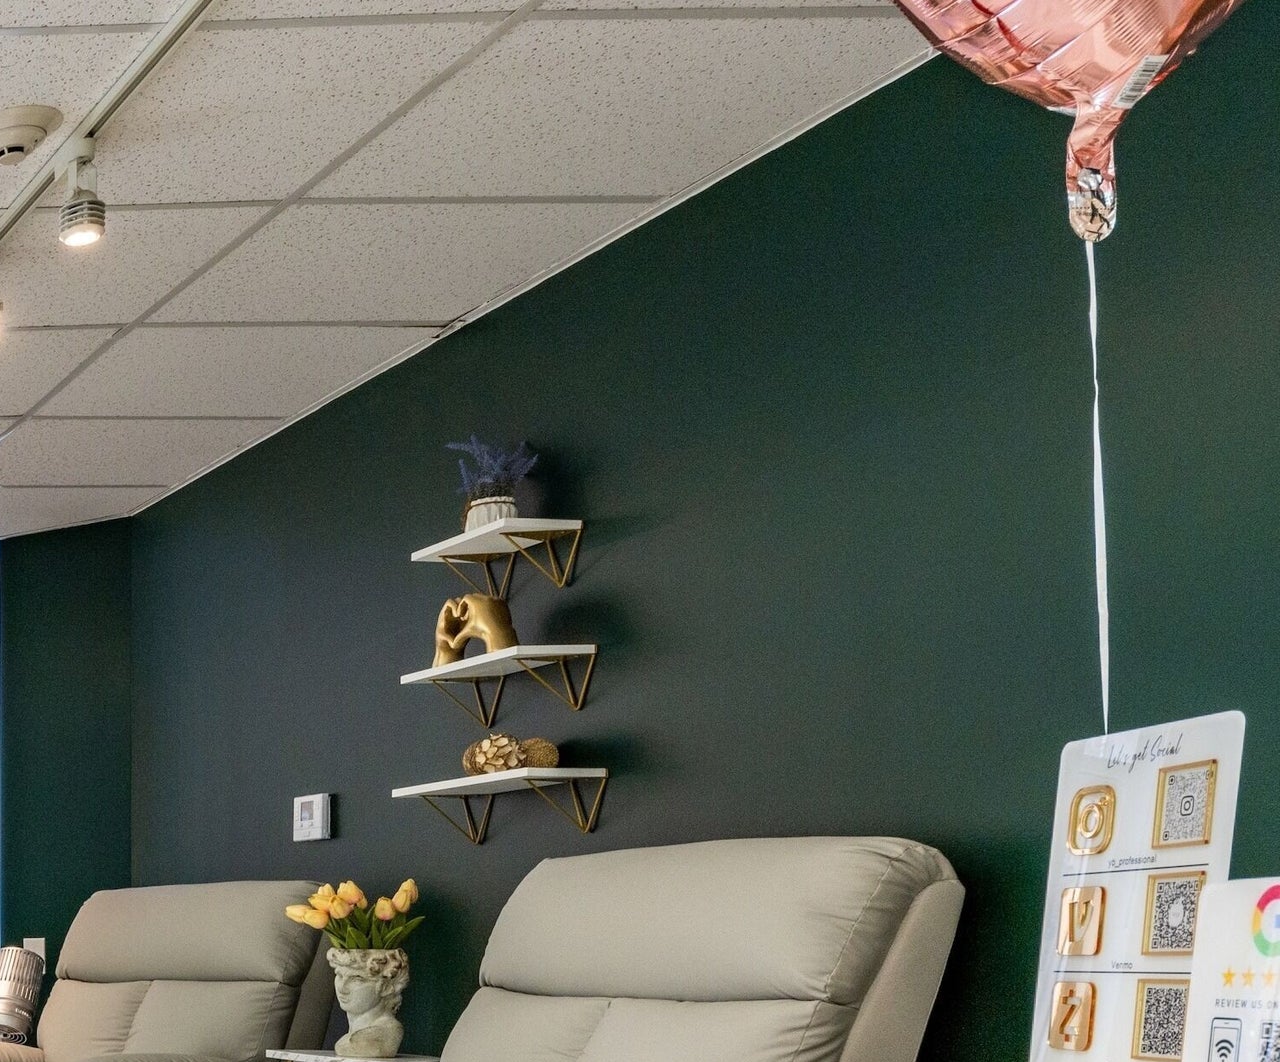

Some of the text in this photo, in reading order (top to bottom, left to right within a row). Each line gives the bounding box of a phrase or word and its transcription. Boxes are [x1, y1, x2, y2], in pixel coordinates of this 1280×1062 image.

[1128, 739, 1150, 773] get
[1150, 733, 1183, 762] Social
[1111, 960, 1134, 970] Venmo
[1215, 998, 1247, 1009] REVIEW
